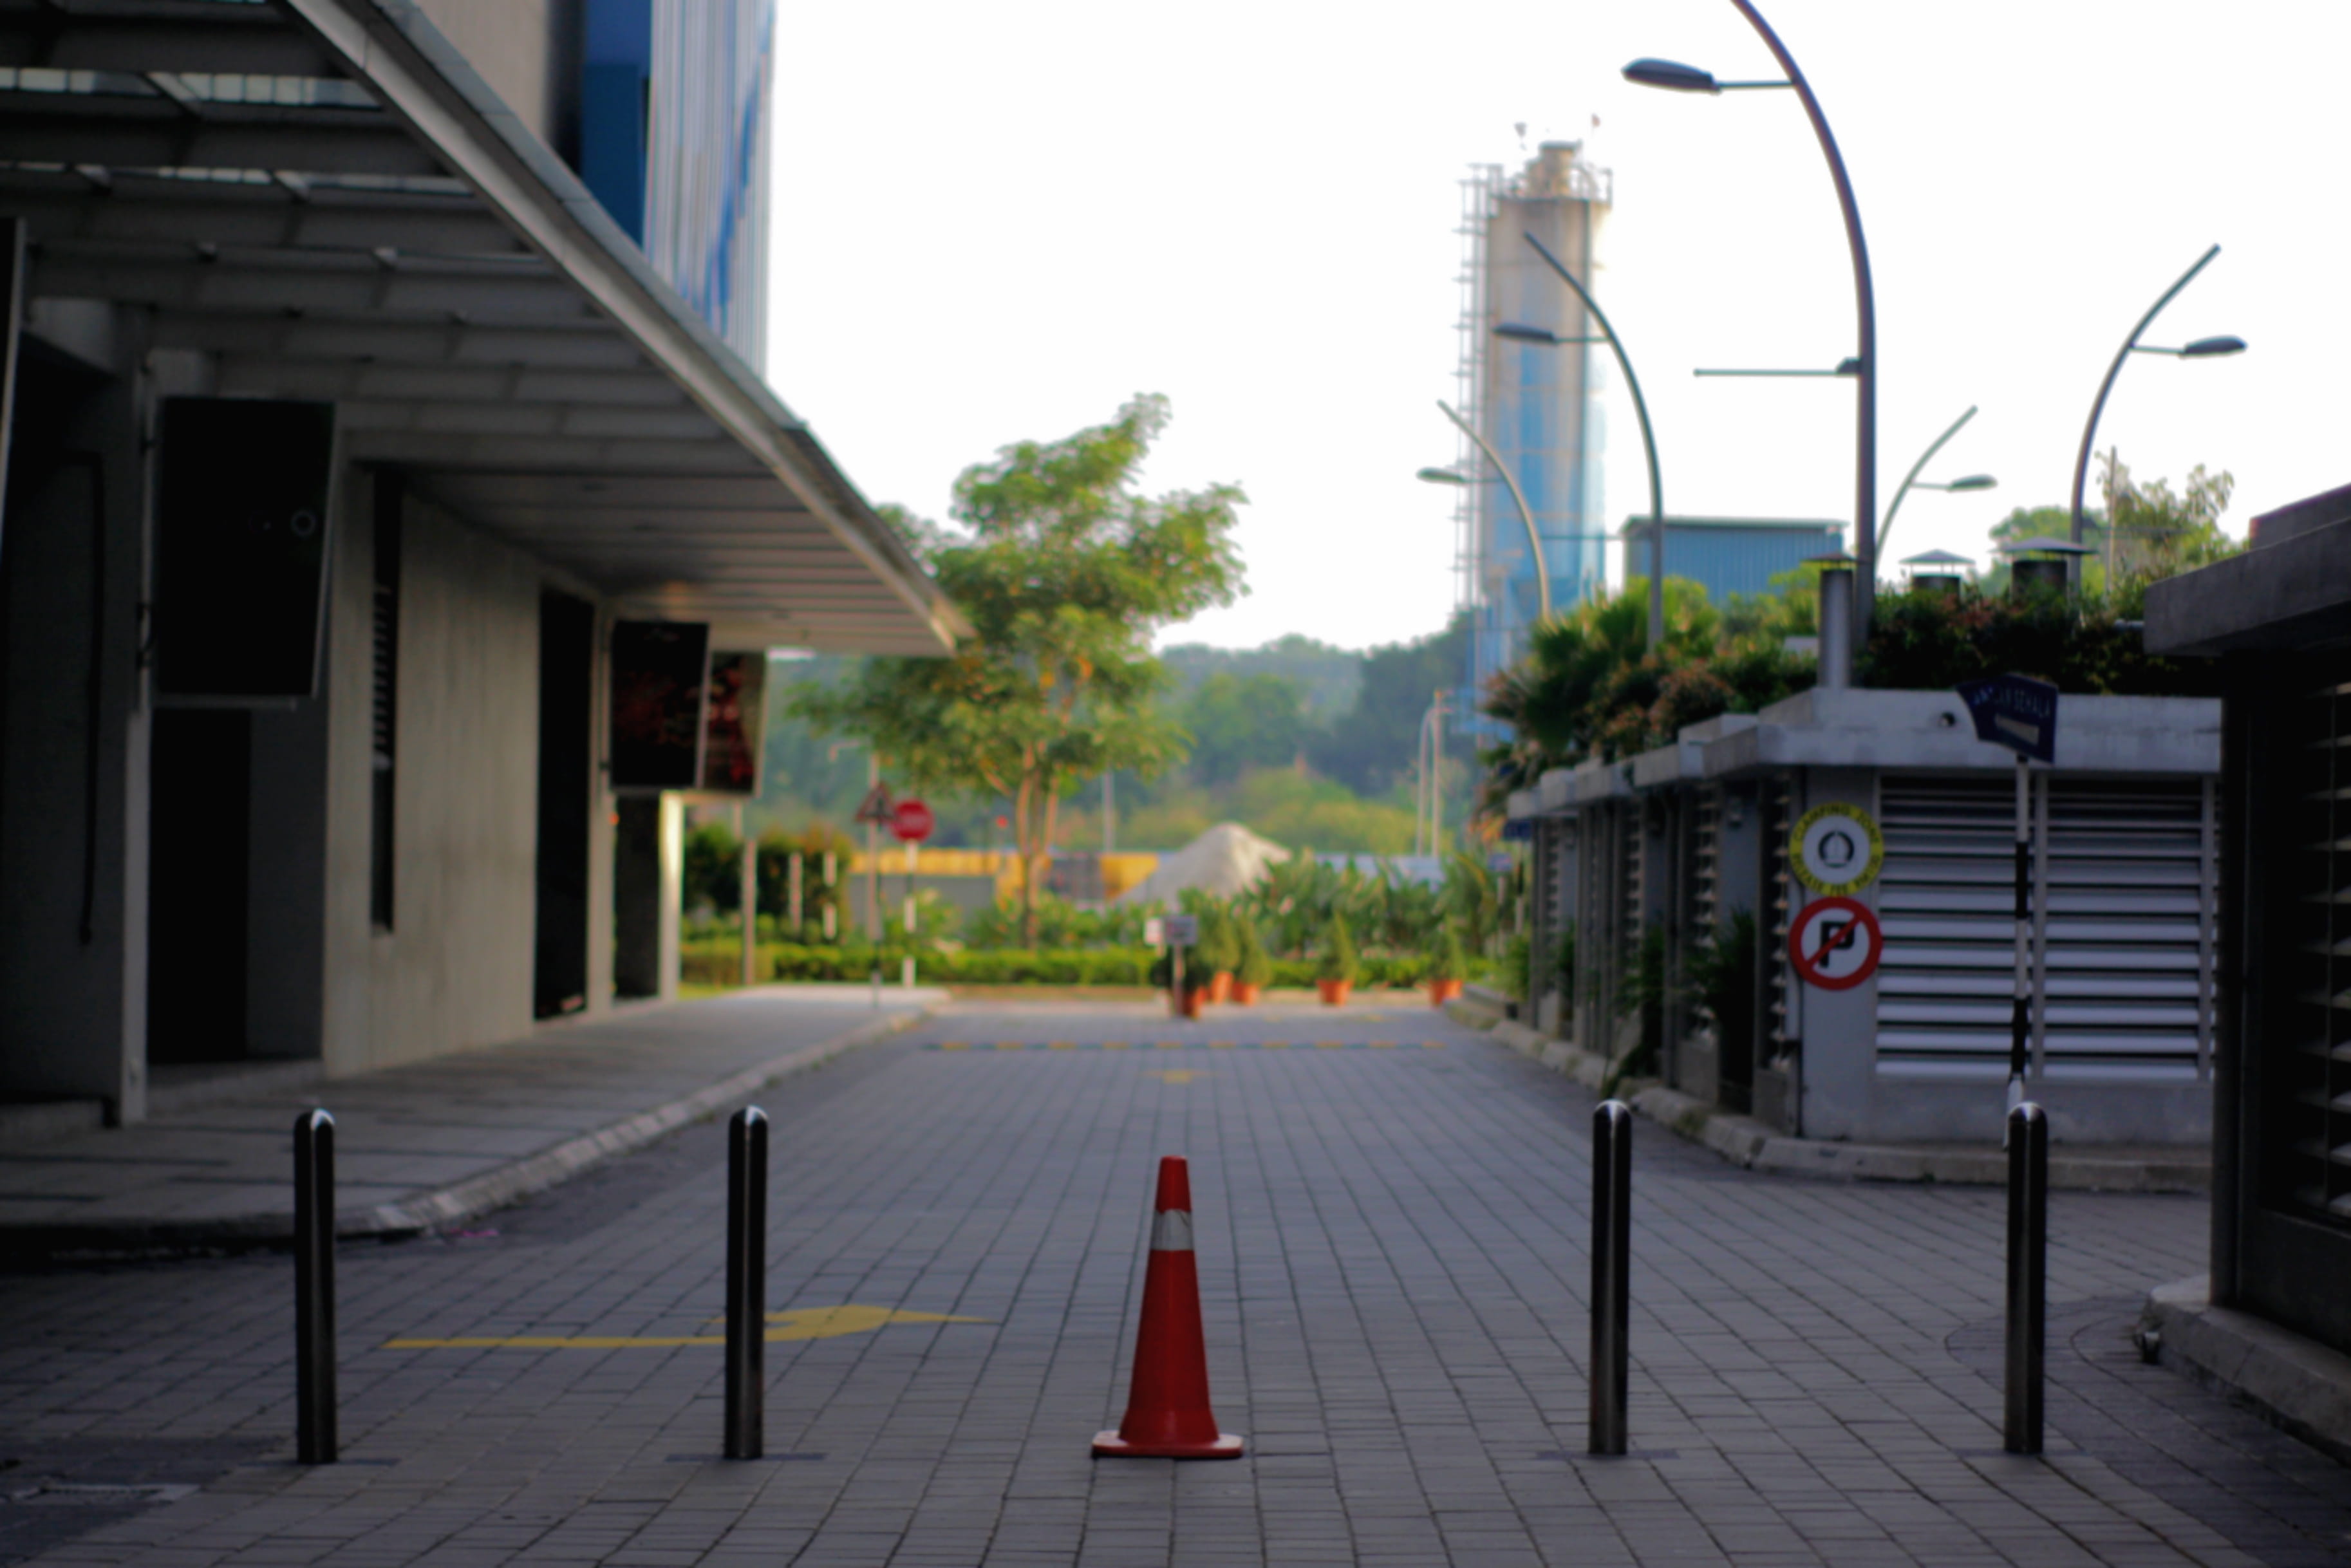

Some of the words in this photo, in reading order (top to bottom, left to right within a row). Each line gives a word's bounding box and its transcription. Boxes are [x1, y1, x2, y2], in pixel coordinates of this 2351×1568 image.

[2014, 689, 2051, 718] SEHALA
[1792, 803, 1851, 839] CLAMPING
[1857, 812, 1882, 846] ZONE
[1820, 921, 1855, 967] P
